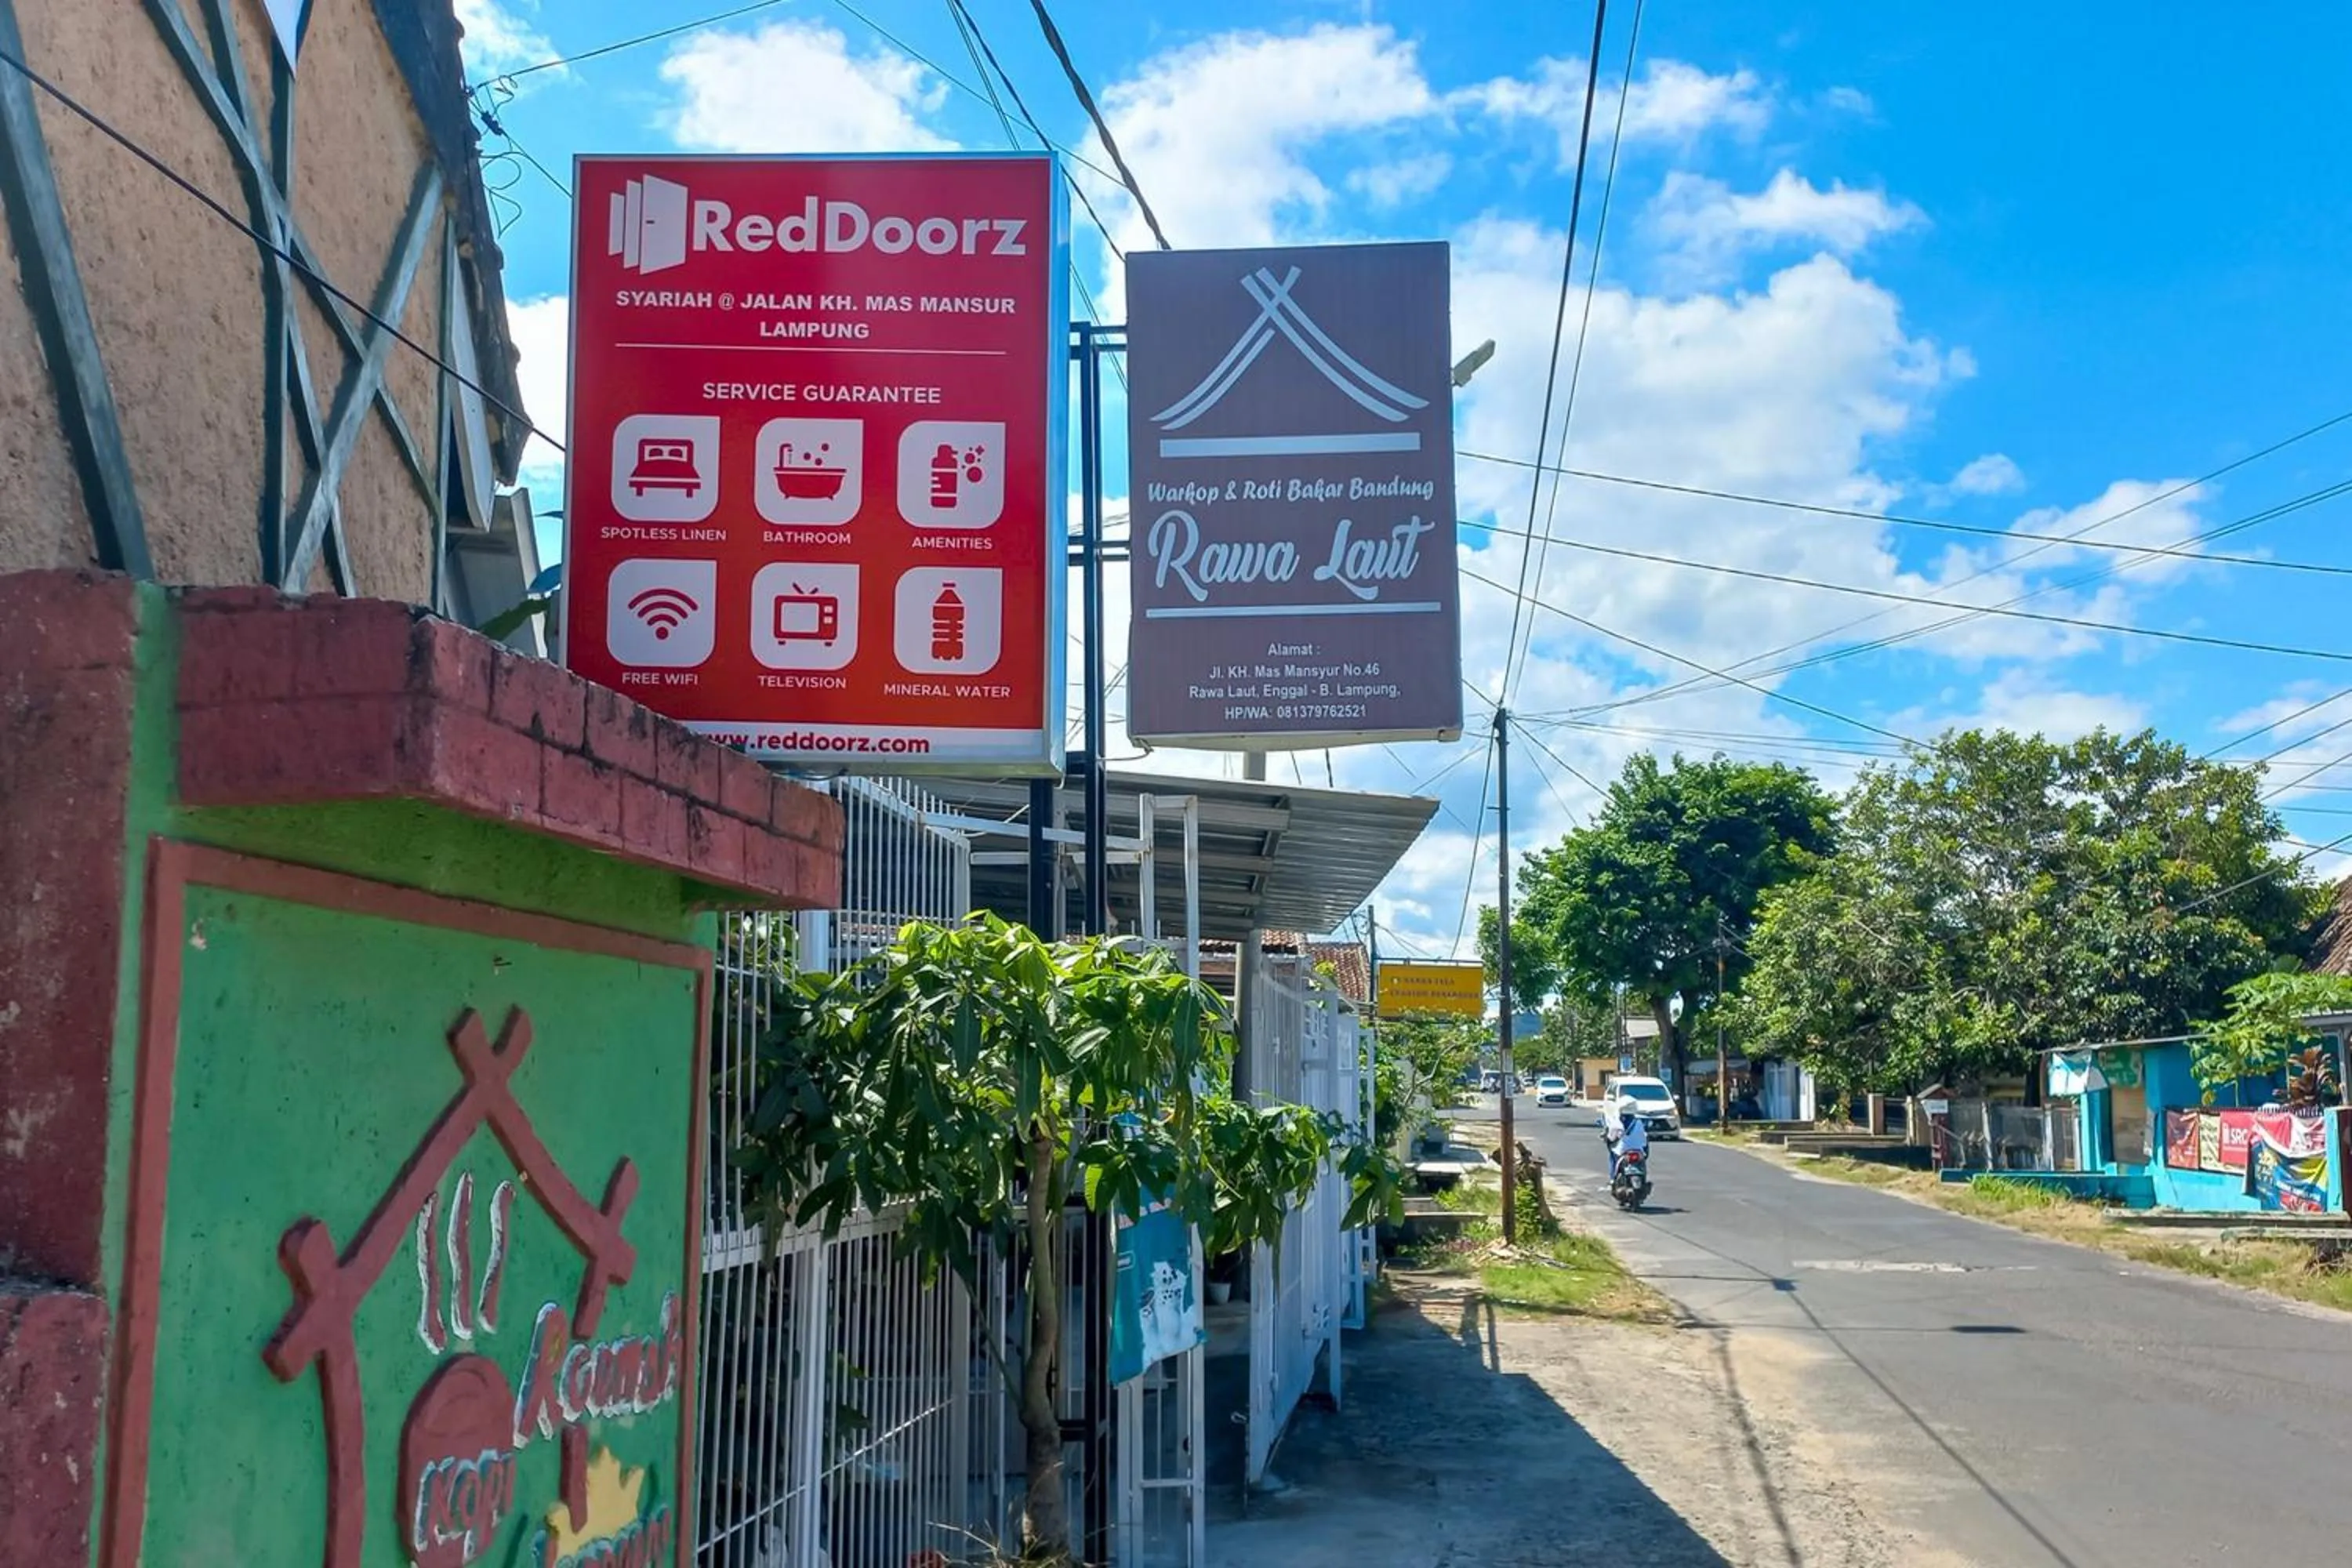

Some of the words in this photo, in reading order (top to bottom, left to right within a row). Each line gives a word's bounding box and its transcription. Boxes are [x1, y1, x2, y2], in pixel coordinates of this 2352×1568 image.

[692, 195, 1028, 256] RedDoorz
[616, 290, 713, 308] SYARIAH
[717, 292, 735, 311] @
[740, 293, 812, 310] JALAN
[819, 295, 858, 311] KH.
[866, 296, 913, 312] MAS
[920, 296, 1015, 314] MANSUR
[760, 321, 869, 339] LAMPUNG
[702, 382, 797, 401] SERVICE
[803, 384, 942, 404] GUARANTEE
[1148, 481, 1219, 506] Warkop
[1224, 480, 1237, 501] &
[1243, 480, 1282, 499] Roti
[1287, 478, 1344, 503] Bakar
[1348, 475, 1434, 501] Bandung
[601, 526, 678, 540] SPOTLESS
[681, 528, 727, 541] LINEN
[763, 531, 851, 544] BATHROOM
[911, 536, 993, 550] AMENITIES
[1148, 510, 1301, 602] Rawa
[1313, 515, 1436, 601] Laut
[1268, 643, 1313, 656] Alamat
[622, 672, 660, 684] FREE
[664, 673, 699, 685] WIFI
[1254, 665, 1281, 678] Mas
[1284, 664, 1341, 680] Mansyur
[757, 675, 847, 689] TELEVISION
[884, 684, 951, 697] MINERAL
[954, 685, 1011, 698] WATER
[1189, 685, 1224, 699] Rawa
[1263, 684, 1308, 700] Enggal
[1276, 704, 1366, 719] 081379762521
[707, 731, 930, 753] ww.reddoorz.com
